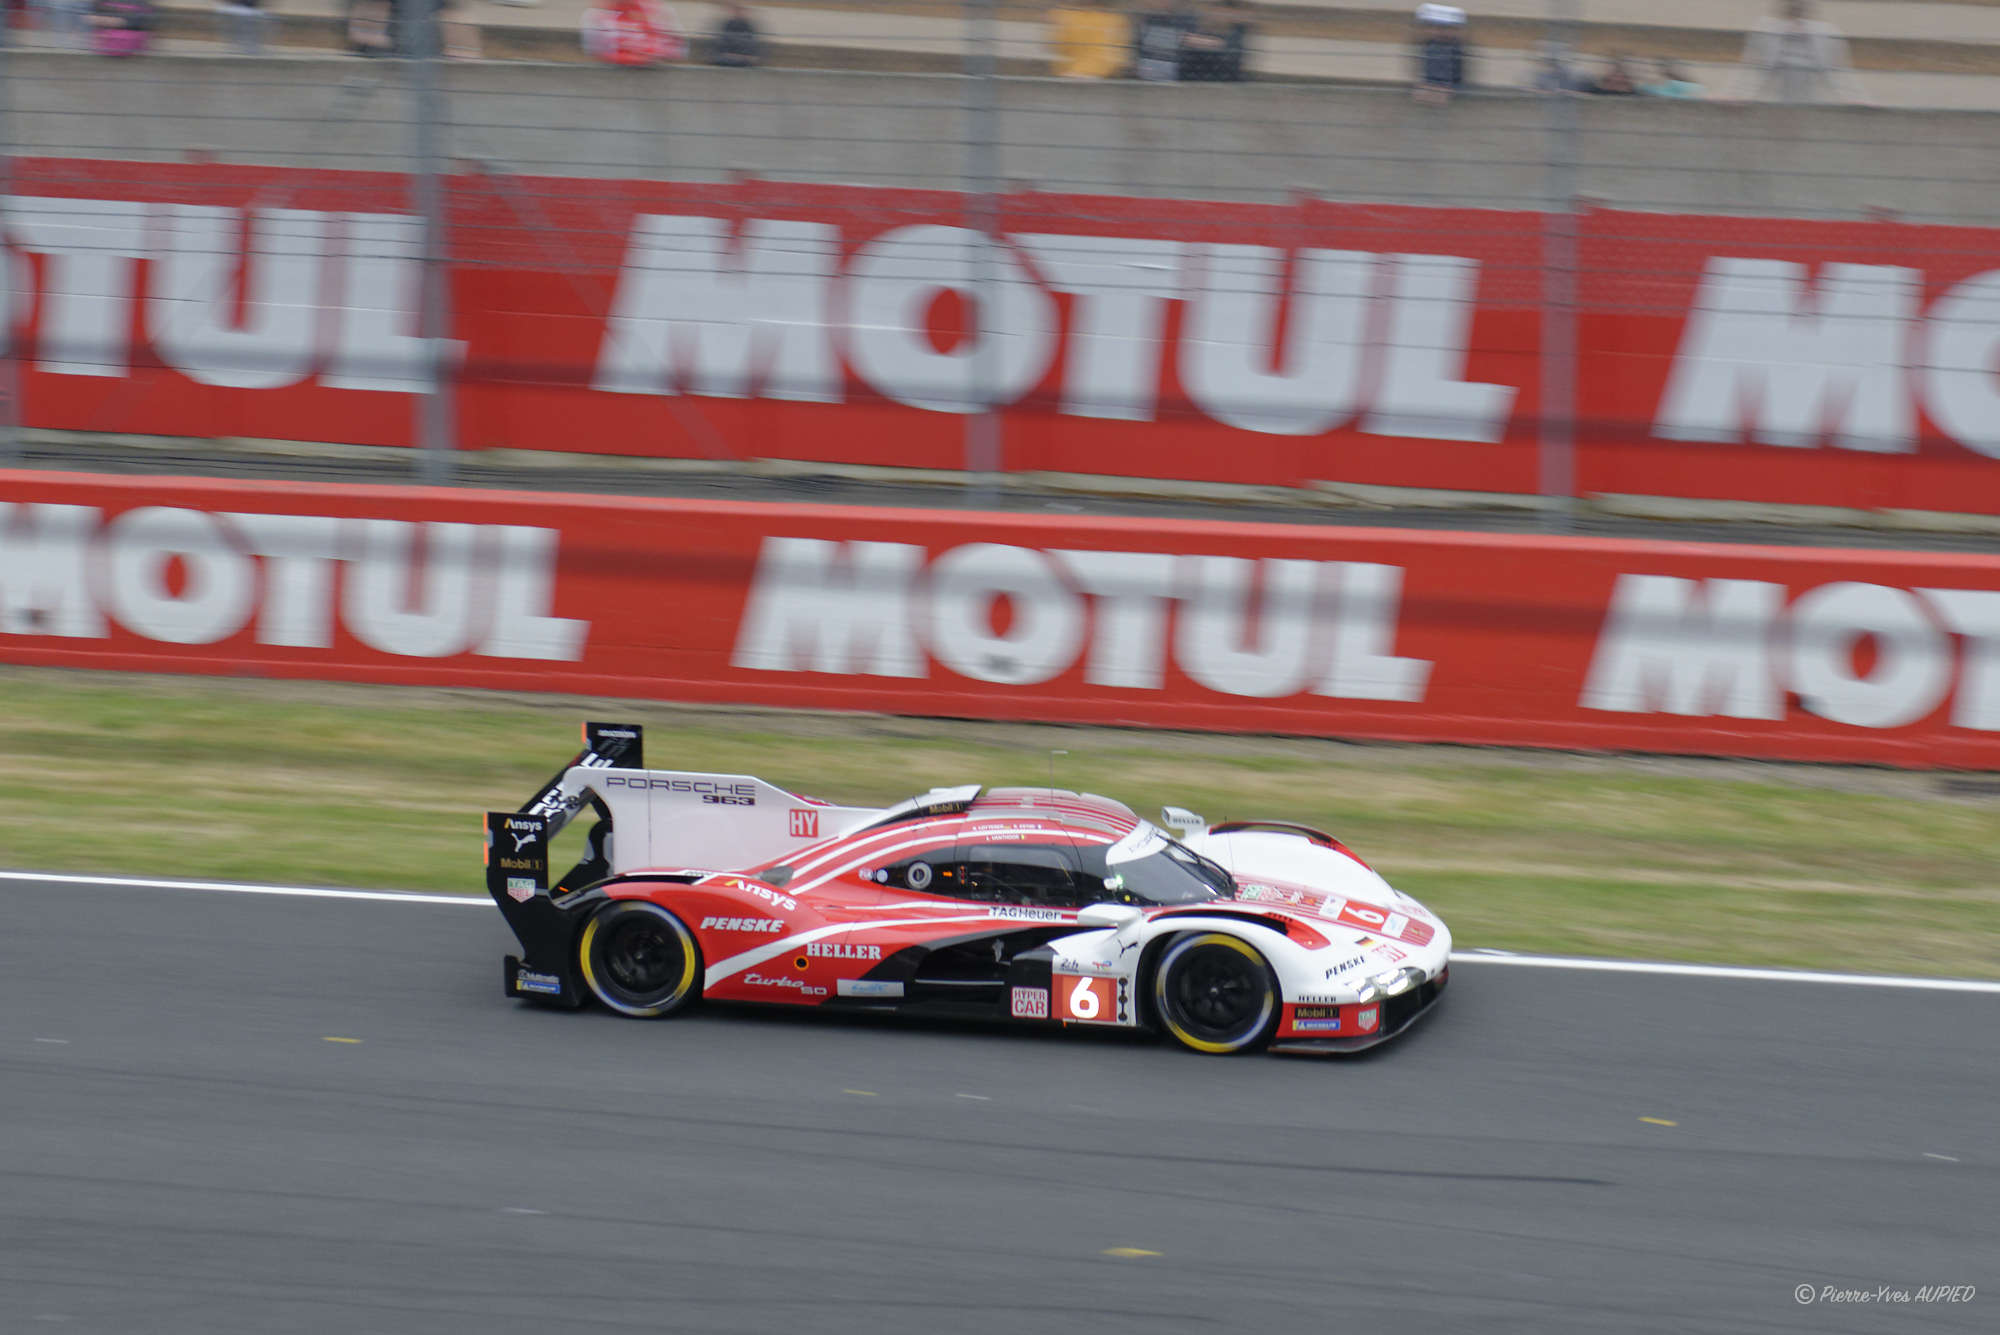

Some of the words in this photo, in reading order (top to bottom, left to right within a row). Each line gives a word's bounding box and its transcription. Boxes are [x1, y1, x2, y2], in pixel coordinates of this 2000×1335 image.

[0, 195, 469, 393] TUL
[589, 213, 1519, 443] MOTUL
[730, 535, 1435, 702] MOTUL
[606, 776, 756, 796] PORSCHE
[702, 795, 756, 806] 963
[504, 817, 543, 833] Ansys
[791, 811, 818, 836] HY
[500, 858, 531, 869] Mobil
[725, 878, 798, 912] Ansys
[1345, 905, 1385, 924] 6
[700, 916, 785, 933] PENSKE
[806, 942, 882, 960] HELLER
[743, 973, 806, 989] turbo
[1014, 990, 1046, 1001] HYPER
[1069, 976, 1100, 1020] 6
[1014, 1000, 1046, 1015] CAR
[1297, 1007, 1326, 1018] Mobil
